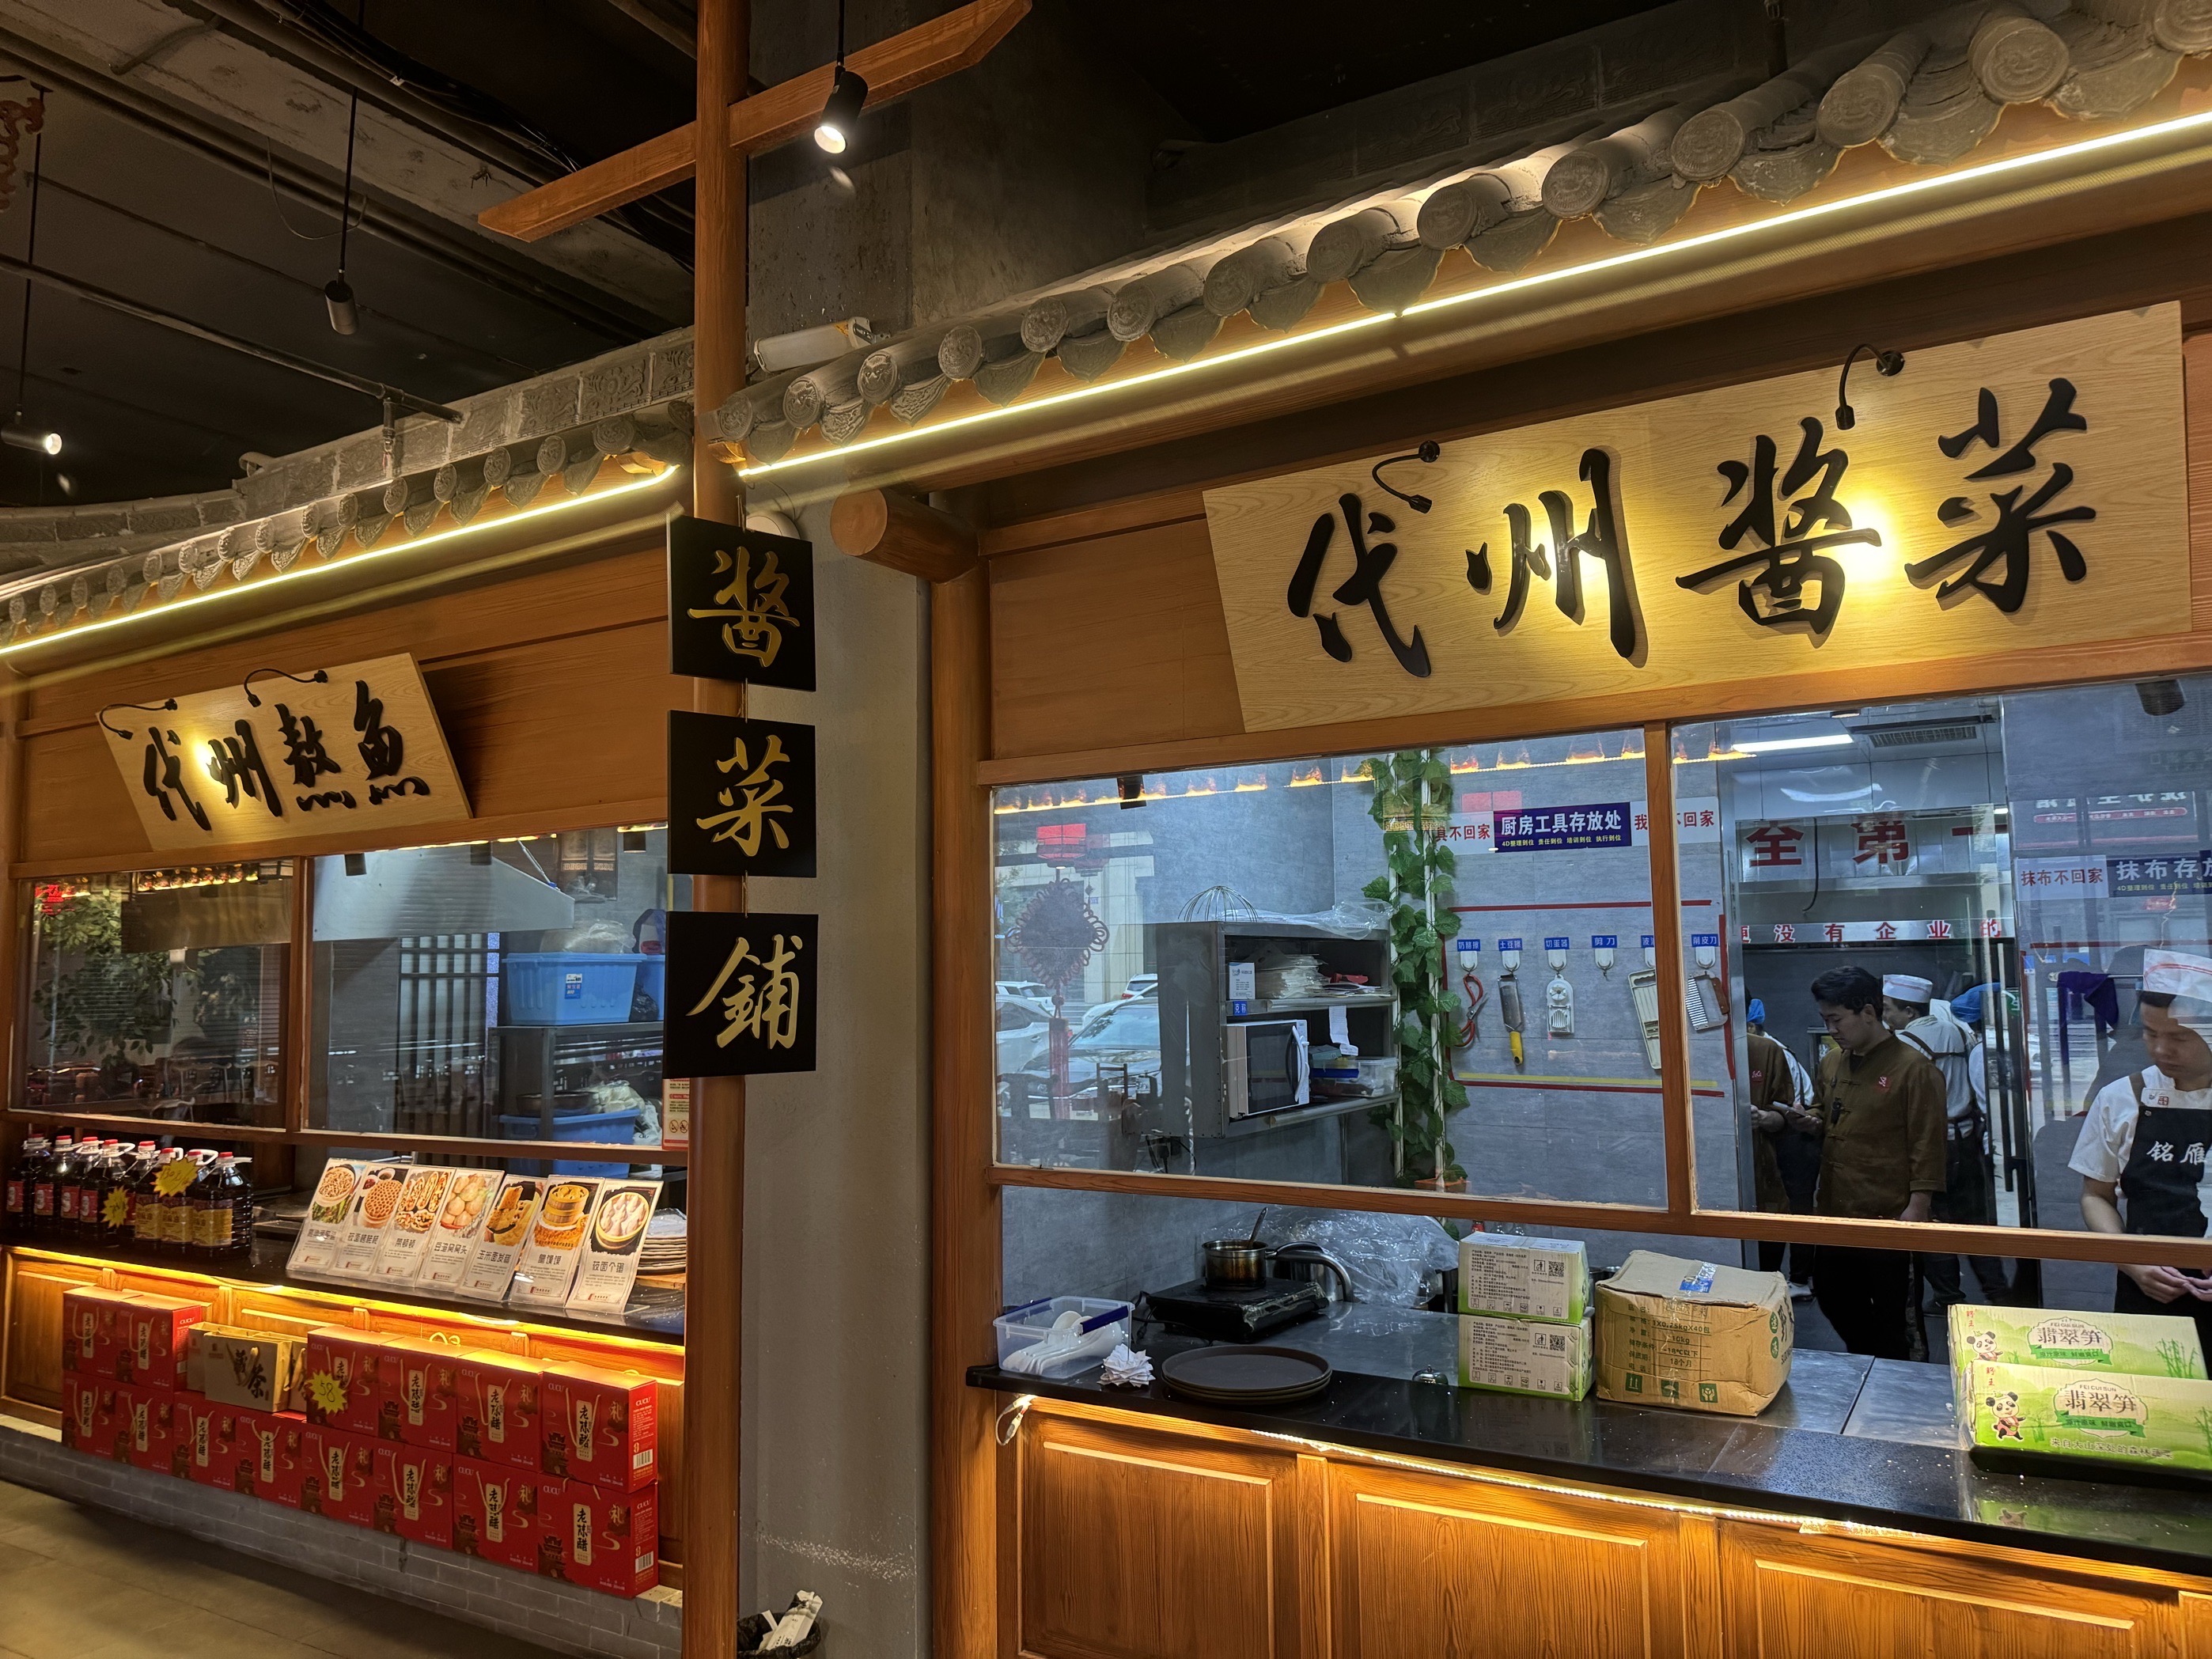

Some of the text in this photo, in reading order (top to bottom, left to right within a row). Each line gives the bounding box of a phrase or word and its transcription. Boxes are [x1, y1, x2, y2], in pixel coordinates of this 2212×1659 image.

[1502, 809, 1621, 836] 厨房工具存放处
[1539, 837, 1562, 846] 责任到位
[1566, 835, 1592, 844] 培训到位
[1596, 835, 1622, 843] 执行到位
[2021, 867, 2103, 887] 抹布不回家
[1594, 937, 1615, 945] 剪刀
[2037, 1327, 2102, 1346] 翡翠笋
[319, 1381, 335, 1403] 58
[2065, 1389, 2137, 1414] 翡翠笋
